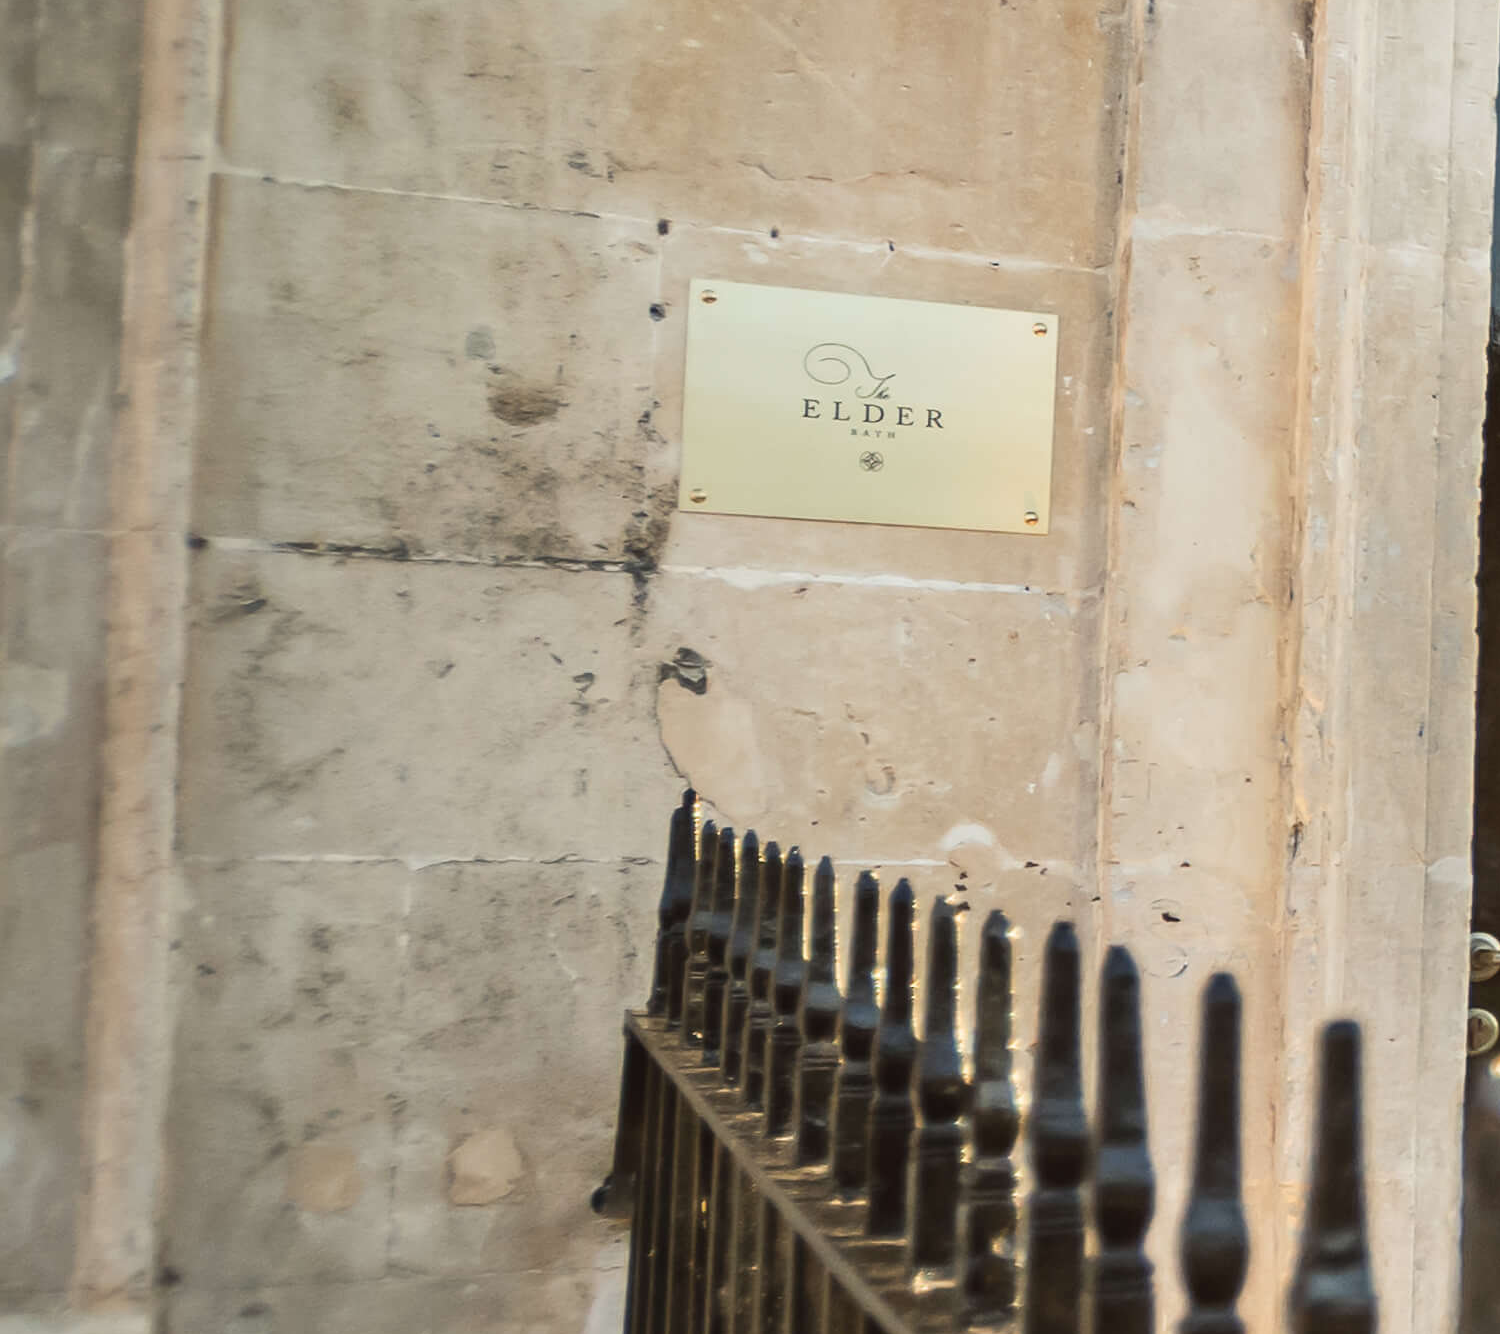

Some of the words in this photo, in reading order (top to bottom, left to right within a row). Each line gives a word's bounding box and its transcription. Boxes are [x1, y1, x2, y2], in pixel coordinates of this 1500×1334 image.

[804, 342, 896, 400] The
[802, 399, 944, 429] ELDER
[850, 428, 896, 439] BATH
